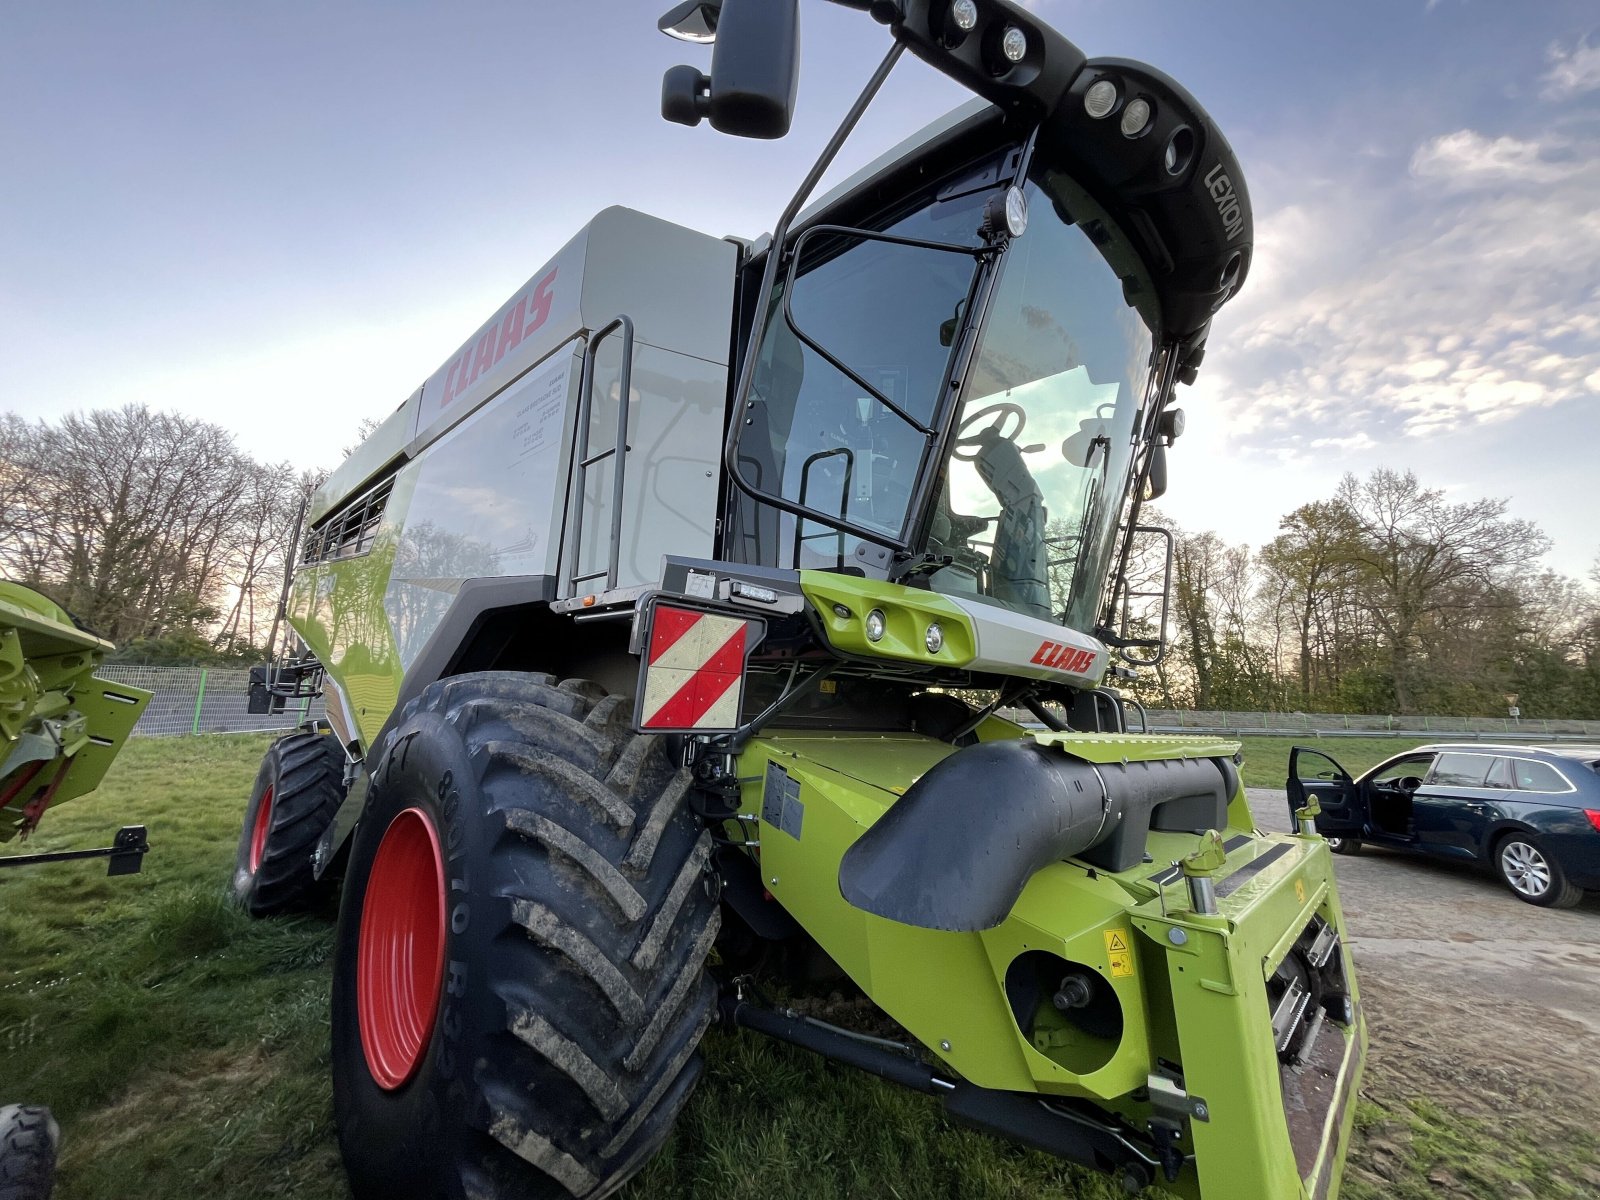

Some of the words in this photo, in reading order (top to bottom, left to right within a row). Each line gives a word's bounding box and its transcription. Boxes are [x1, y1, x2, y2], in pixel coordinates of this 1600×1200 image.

[1204, 163, 1244, 242] LEXION
[439, 265, 559, 410] CLAAS
[1029, 640, 1096, 674] CLAAS
